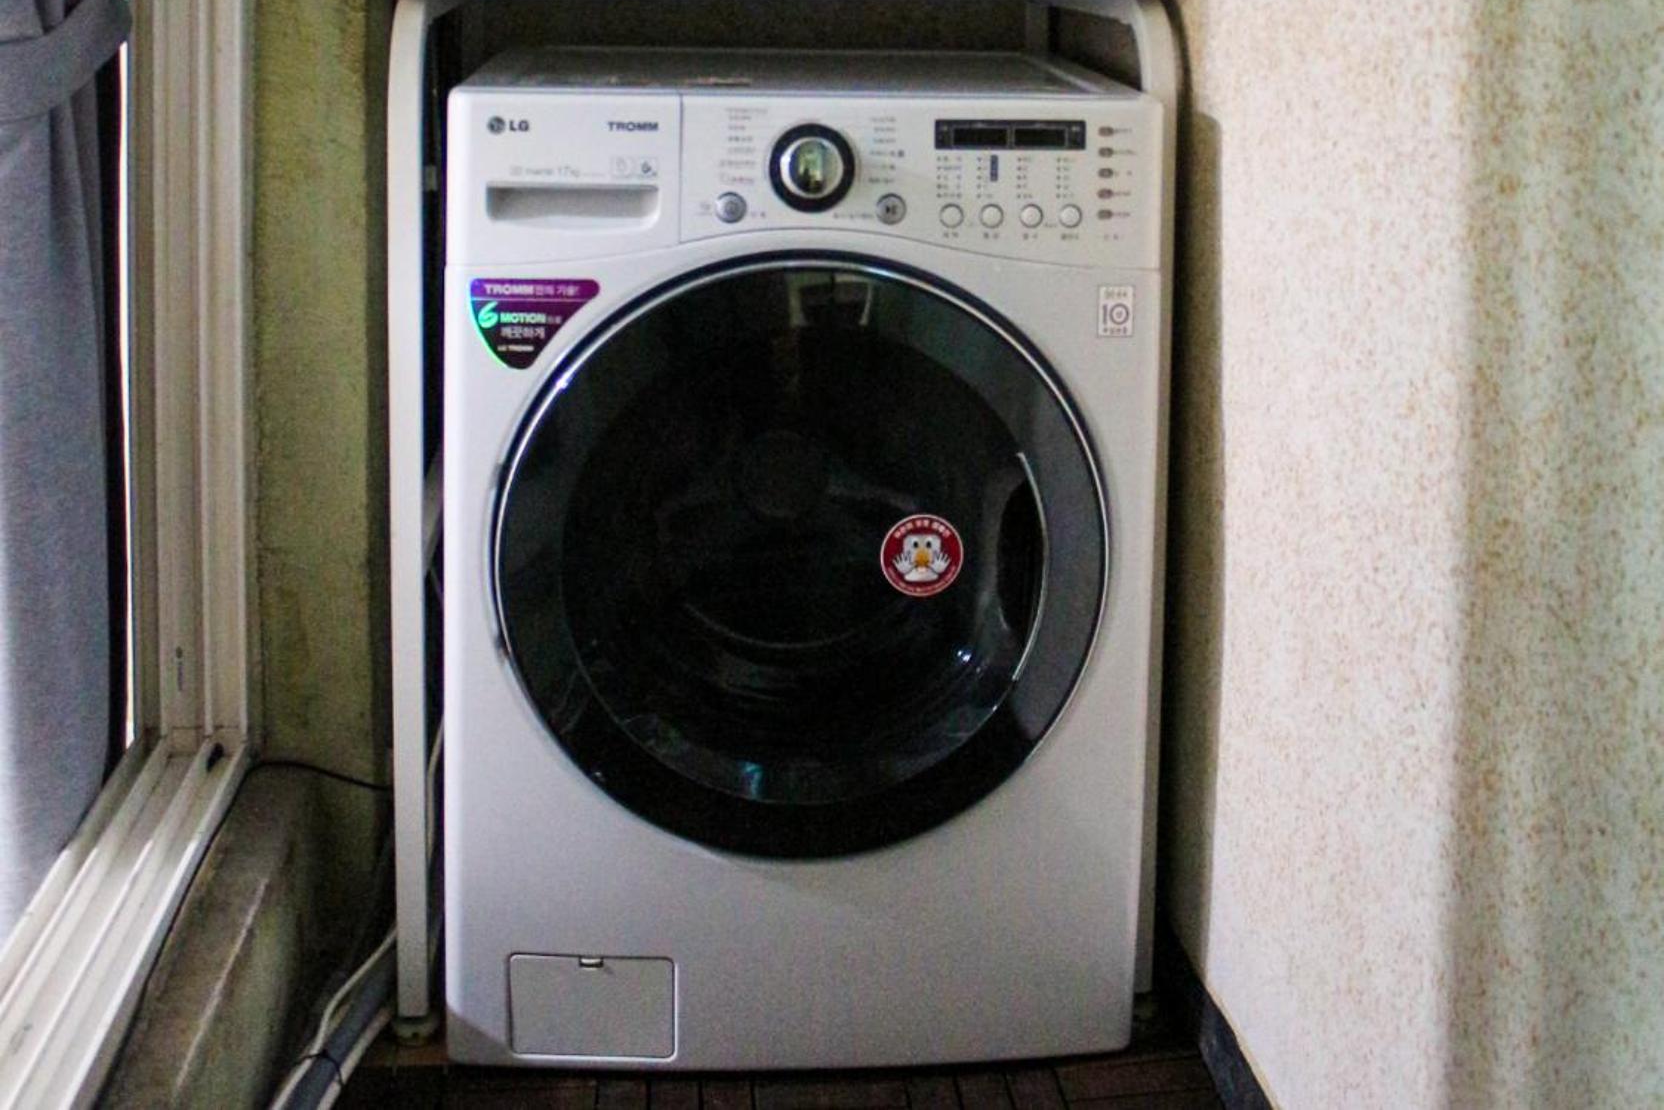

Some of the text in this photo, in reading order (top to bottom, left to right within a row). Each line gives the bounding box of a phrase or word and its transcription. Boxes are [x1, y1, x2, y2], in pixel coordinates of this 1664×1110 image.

[509, 120, 529, 132] LG
[608, 121, 659, 131] TROMM
[500, 312, 547, 324] MOTION
